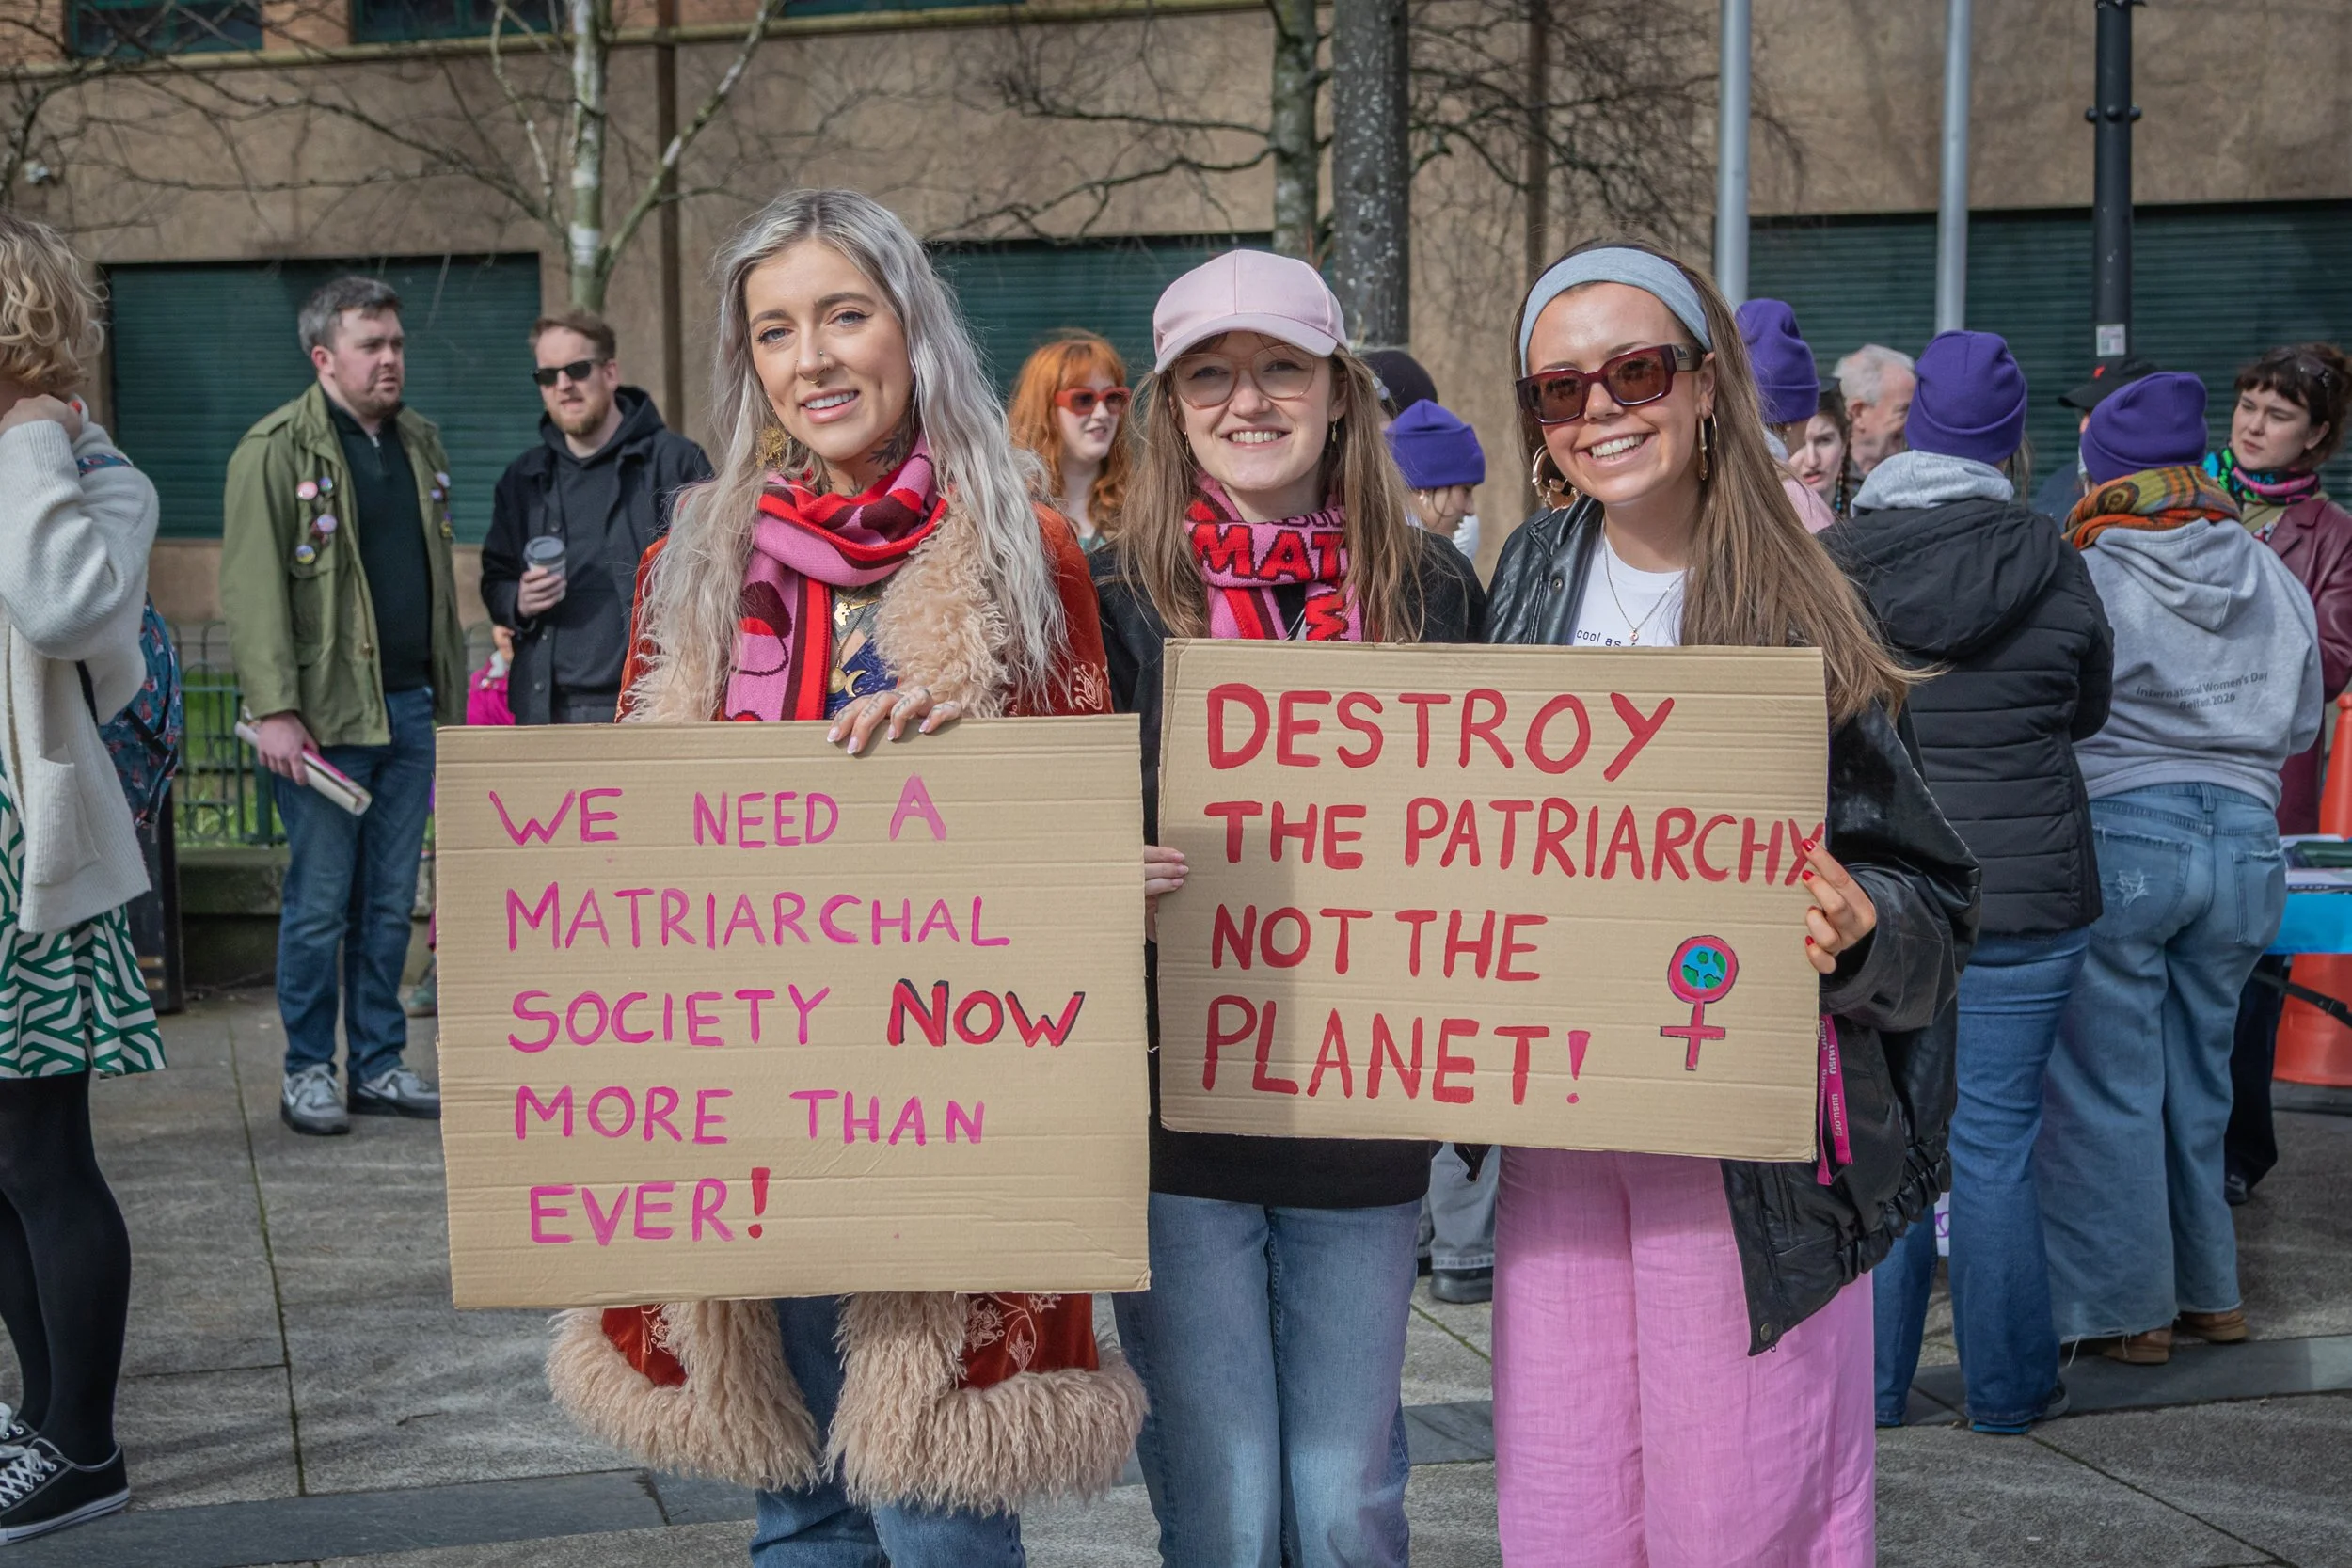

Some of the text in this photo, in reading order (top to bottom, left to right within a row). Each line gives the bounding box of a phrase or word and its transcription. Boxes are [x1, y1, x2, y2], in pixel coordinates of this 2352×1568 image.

[1576, 629, 1622, 646] cool as
[2137, 672, 2268, 699] International Women's Day
[2212, 691, 2236, 705] 2026
[1207, 683, 1675, 782] DESTROY
[489, 773, 948, 848] WE NEED A
[1204, 798, 1824, 886] THE PATRIARCHY
[506, 881, 1010, 952] MATRIARCHAL
[1212, 904, 1549, 982] NOT THE
[508, 978, 1087, 1053] SOCIETY NOW
[1202, 995, 1592, 1106] PLANET!
[515, 1085, 985, 1147] MORE THAN
[1831, 1093, 1843, 1137] uusu.org
[530, 1167, 771, 1246] EVER!
